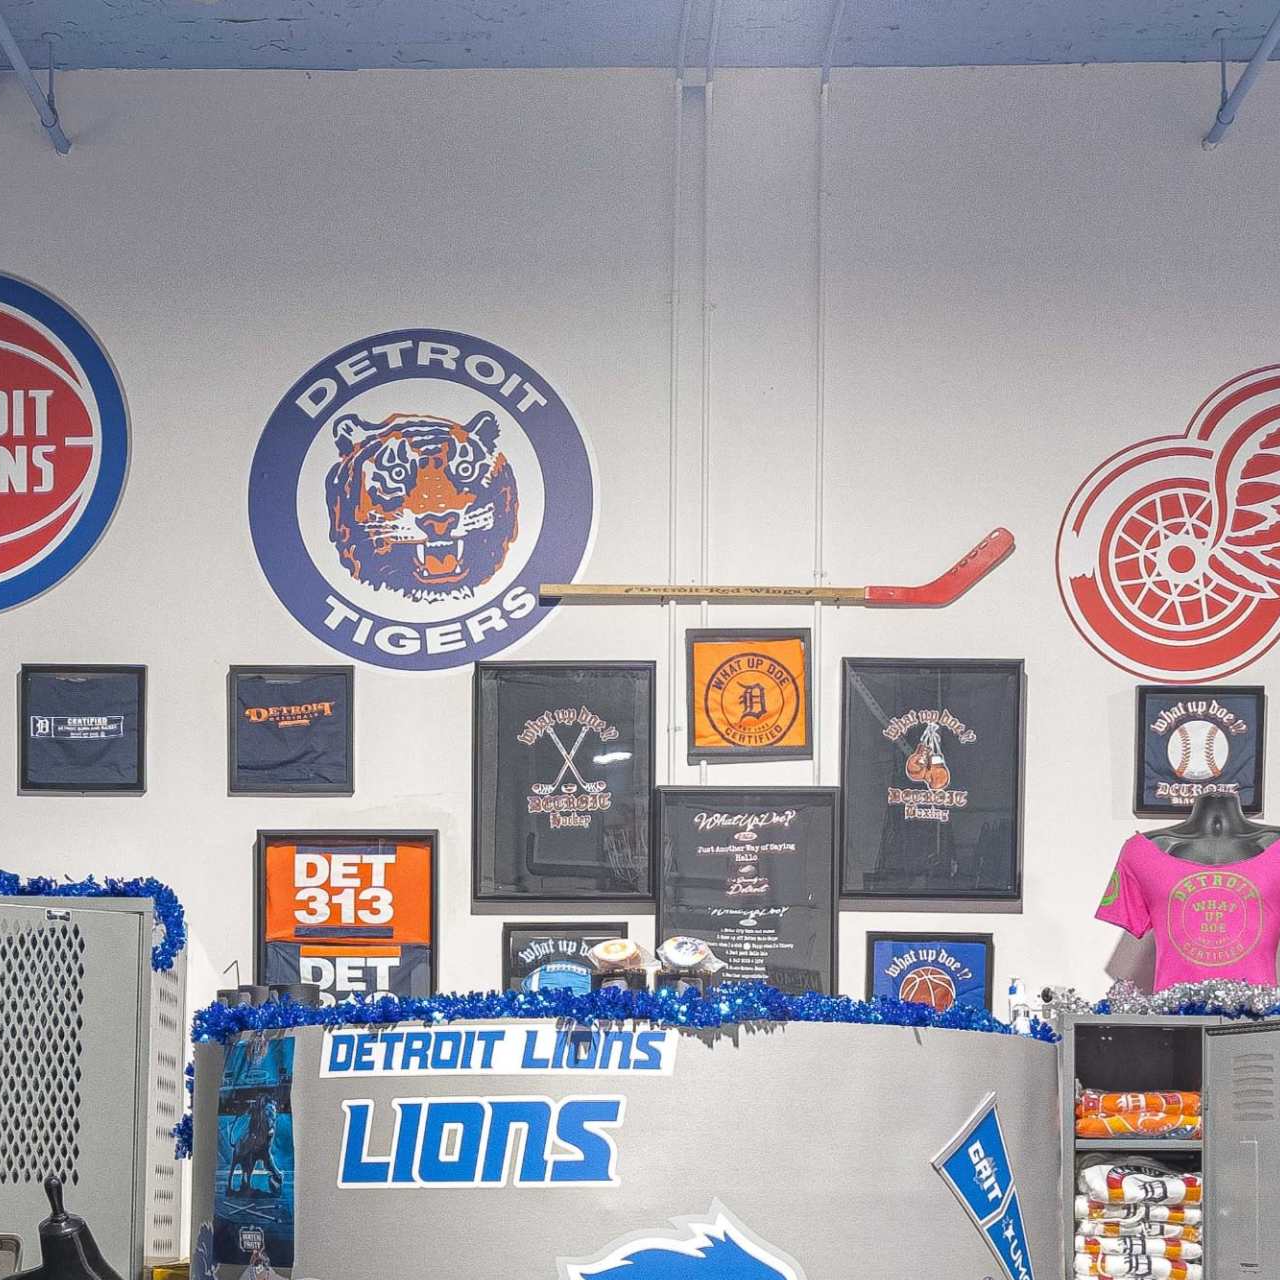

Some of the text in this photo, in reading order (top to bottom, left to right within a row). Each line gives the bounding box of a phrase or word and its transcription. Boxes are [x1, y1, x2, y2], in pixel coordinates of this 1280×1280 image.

[296, 339, 549, 421] DETROIT
[323, 582, 539, 657] TIGERS
[711, 657, 790, 691] WHAT UP DOE
[724, 723, 783, 745] CERTIFIED
[1150, 701, 1187, 735] what
[1186, 701, 1207, 714] up
[1208, 699, 1235, 723] doe
[294, 853, 396, 888] DET
[1173, 874, 1258, 901] DETROIT
[293, 887, 395, 925] 313
[1192, 899, 1237, 913] WHAT
[519, 938, 556, 964] what
[556, 939, 578, 957] up
[884, 949, 918, 978] what
[918, 949, 936, 963] up
[937, 948, 961, 971] doe
[299, 956, 401, 993] DET
[327, 1029, 667, 1073] DETROIT LIONS
[337, 1096, 625, 1188] LIONS
[968, 1139, 1003, 1203] GRIT
